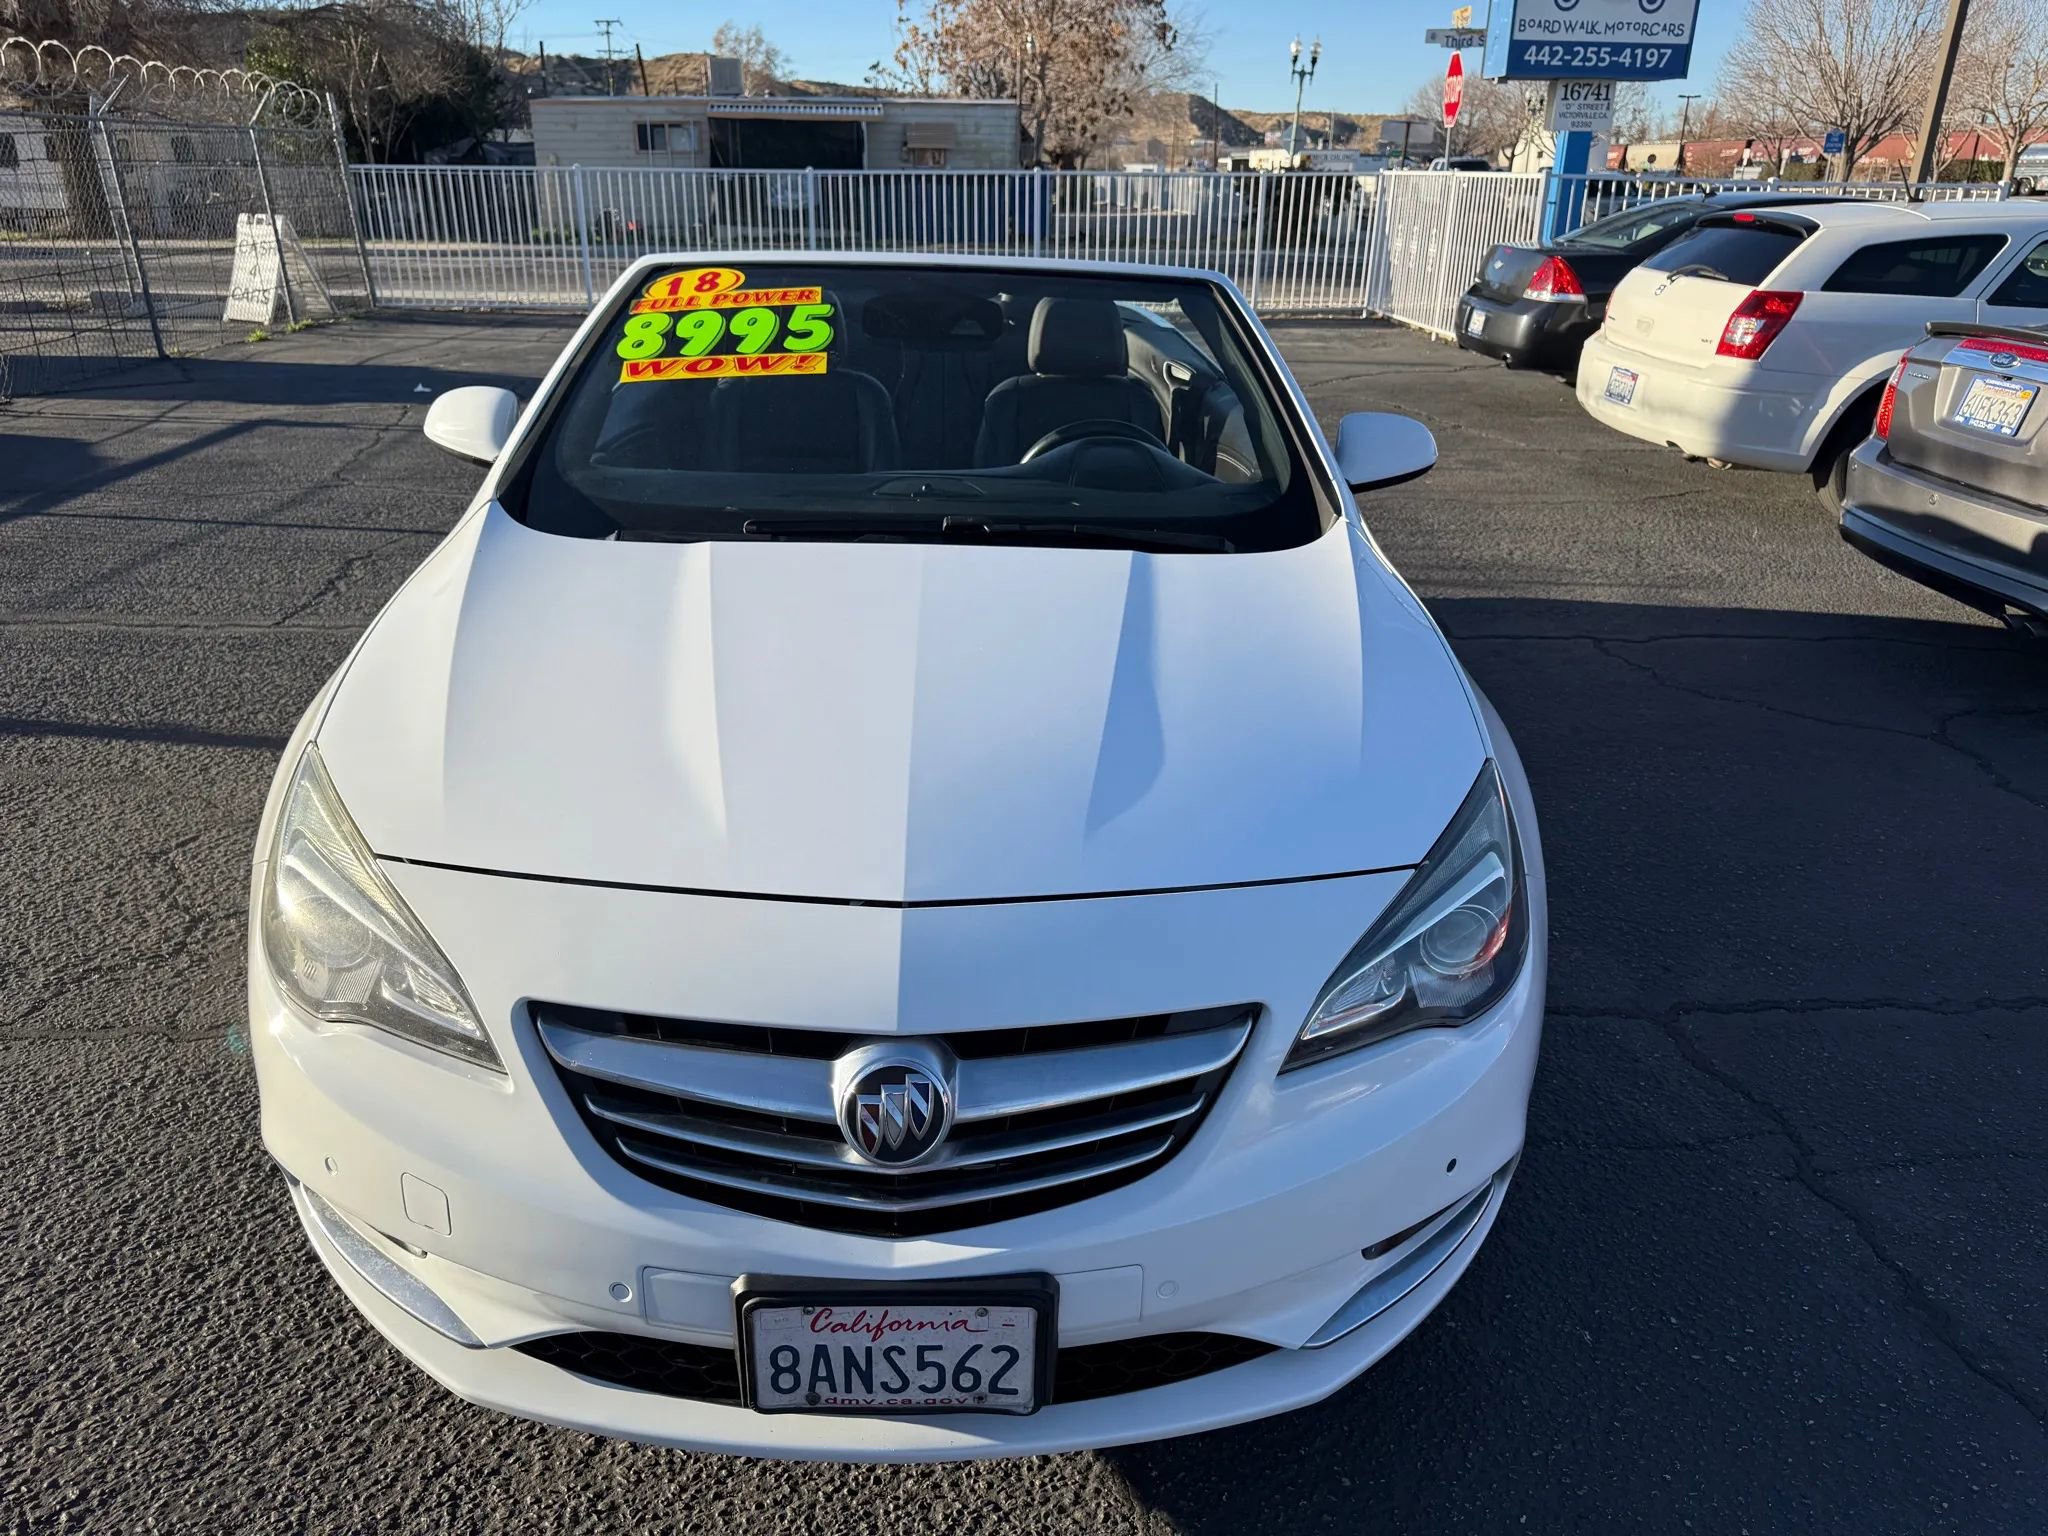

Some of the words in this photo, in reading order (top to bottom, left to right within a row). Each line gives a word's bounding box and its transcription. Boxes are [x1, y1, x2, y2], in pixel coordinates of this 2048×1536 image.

[1444, 35, 1474, 48] Third
[1478, 35, 1486, 48] S
[1603, 21, 1686, 38] MOTORCARS
[1523, 45, 1673, 69] 442-255-4197
[1444, 75, 1463, 104] STOP
[1560, 82, 1611, 102] 16741
[1576, 103, 1605, 111] STREET
[249, 265, 257, 279] 4
[665, 271, 722, 296] 18
[231, 285, 270, 305] CARS
[631, 296, 702, 313] FULL
[711, 289, 818, 307] POWER
[616, 304, 836, 360] 8995
[626, 353, 824, 379] WOW!
[809, 1306, 989, 1343] California
[768, 1344, 1020, 1396] 8ANS562
[823, 1396, 969, 1406] dmv.ca.gov
